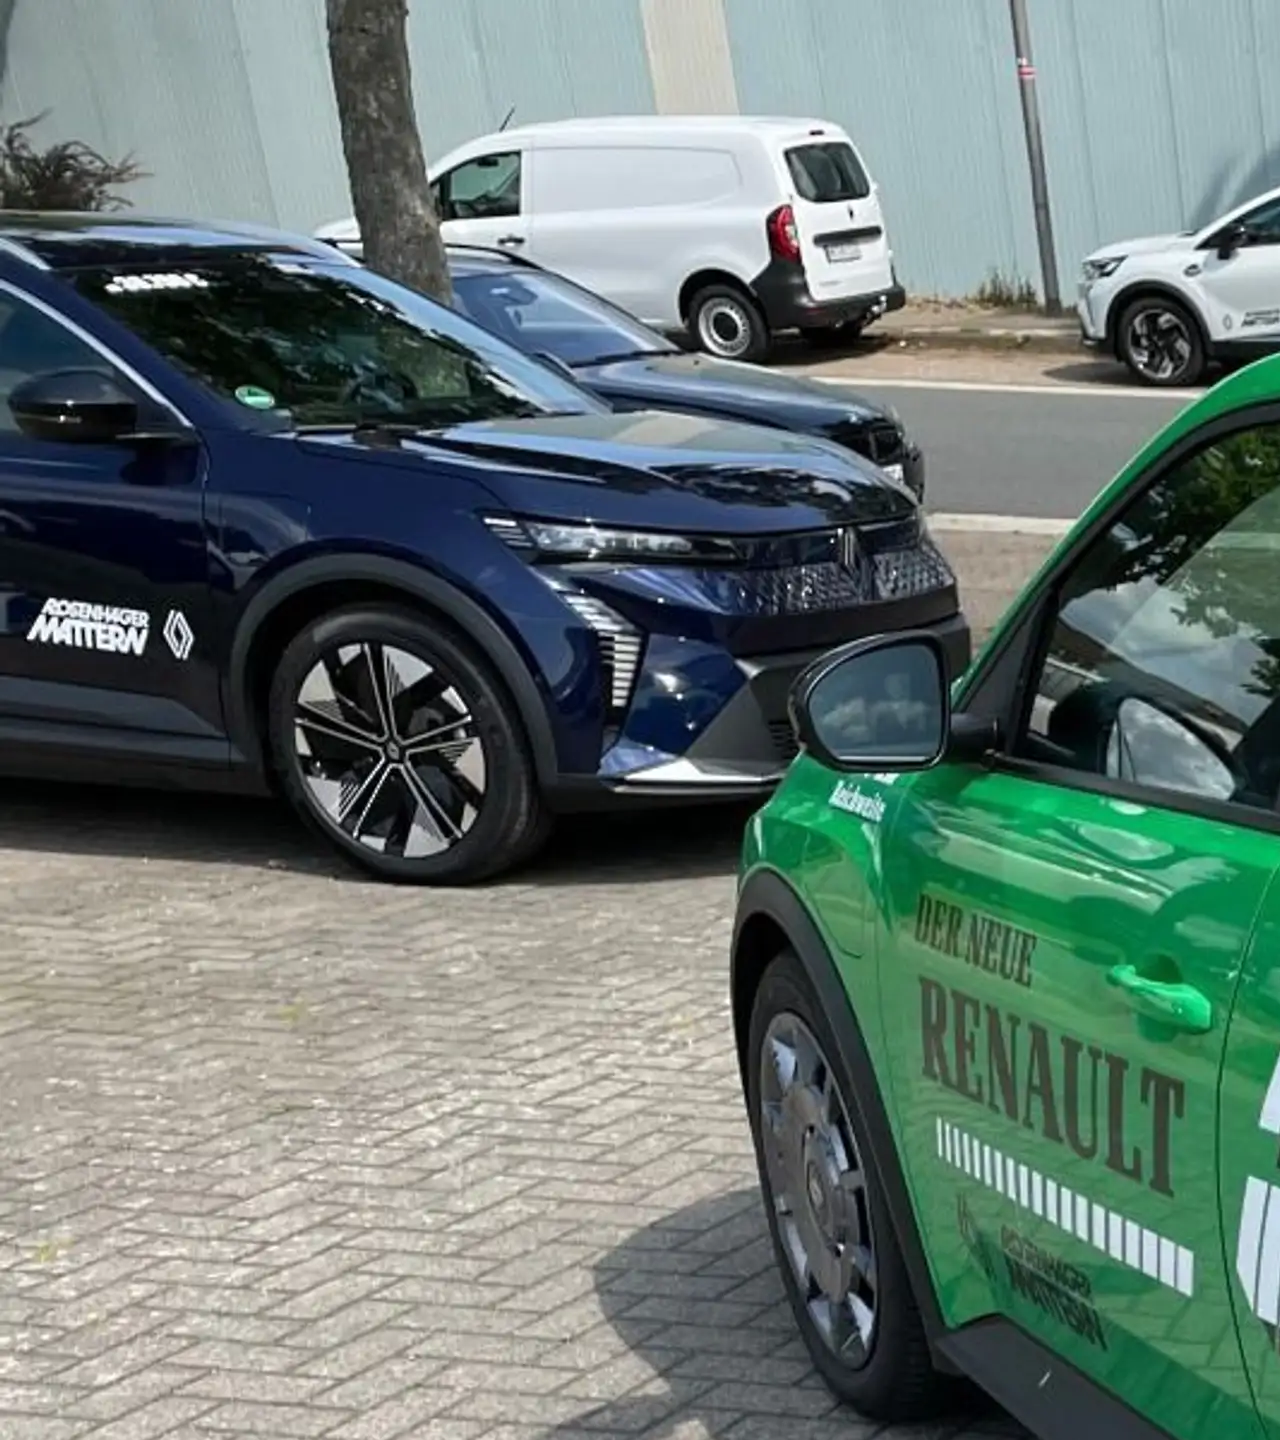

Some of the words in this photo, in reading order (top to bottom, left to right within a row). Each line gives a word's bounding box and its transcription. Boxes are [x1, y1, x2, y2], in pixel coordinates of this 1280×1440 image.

[27, 614, 148, 654] MATTERN
[914, 892, 964, 960] DER
[967, 912, 1037, 988] NEUE
[918, 973, 1186, 1199] RENAULT
